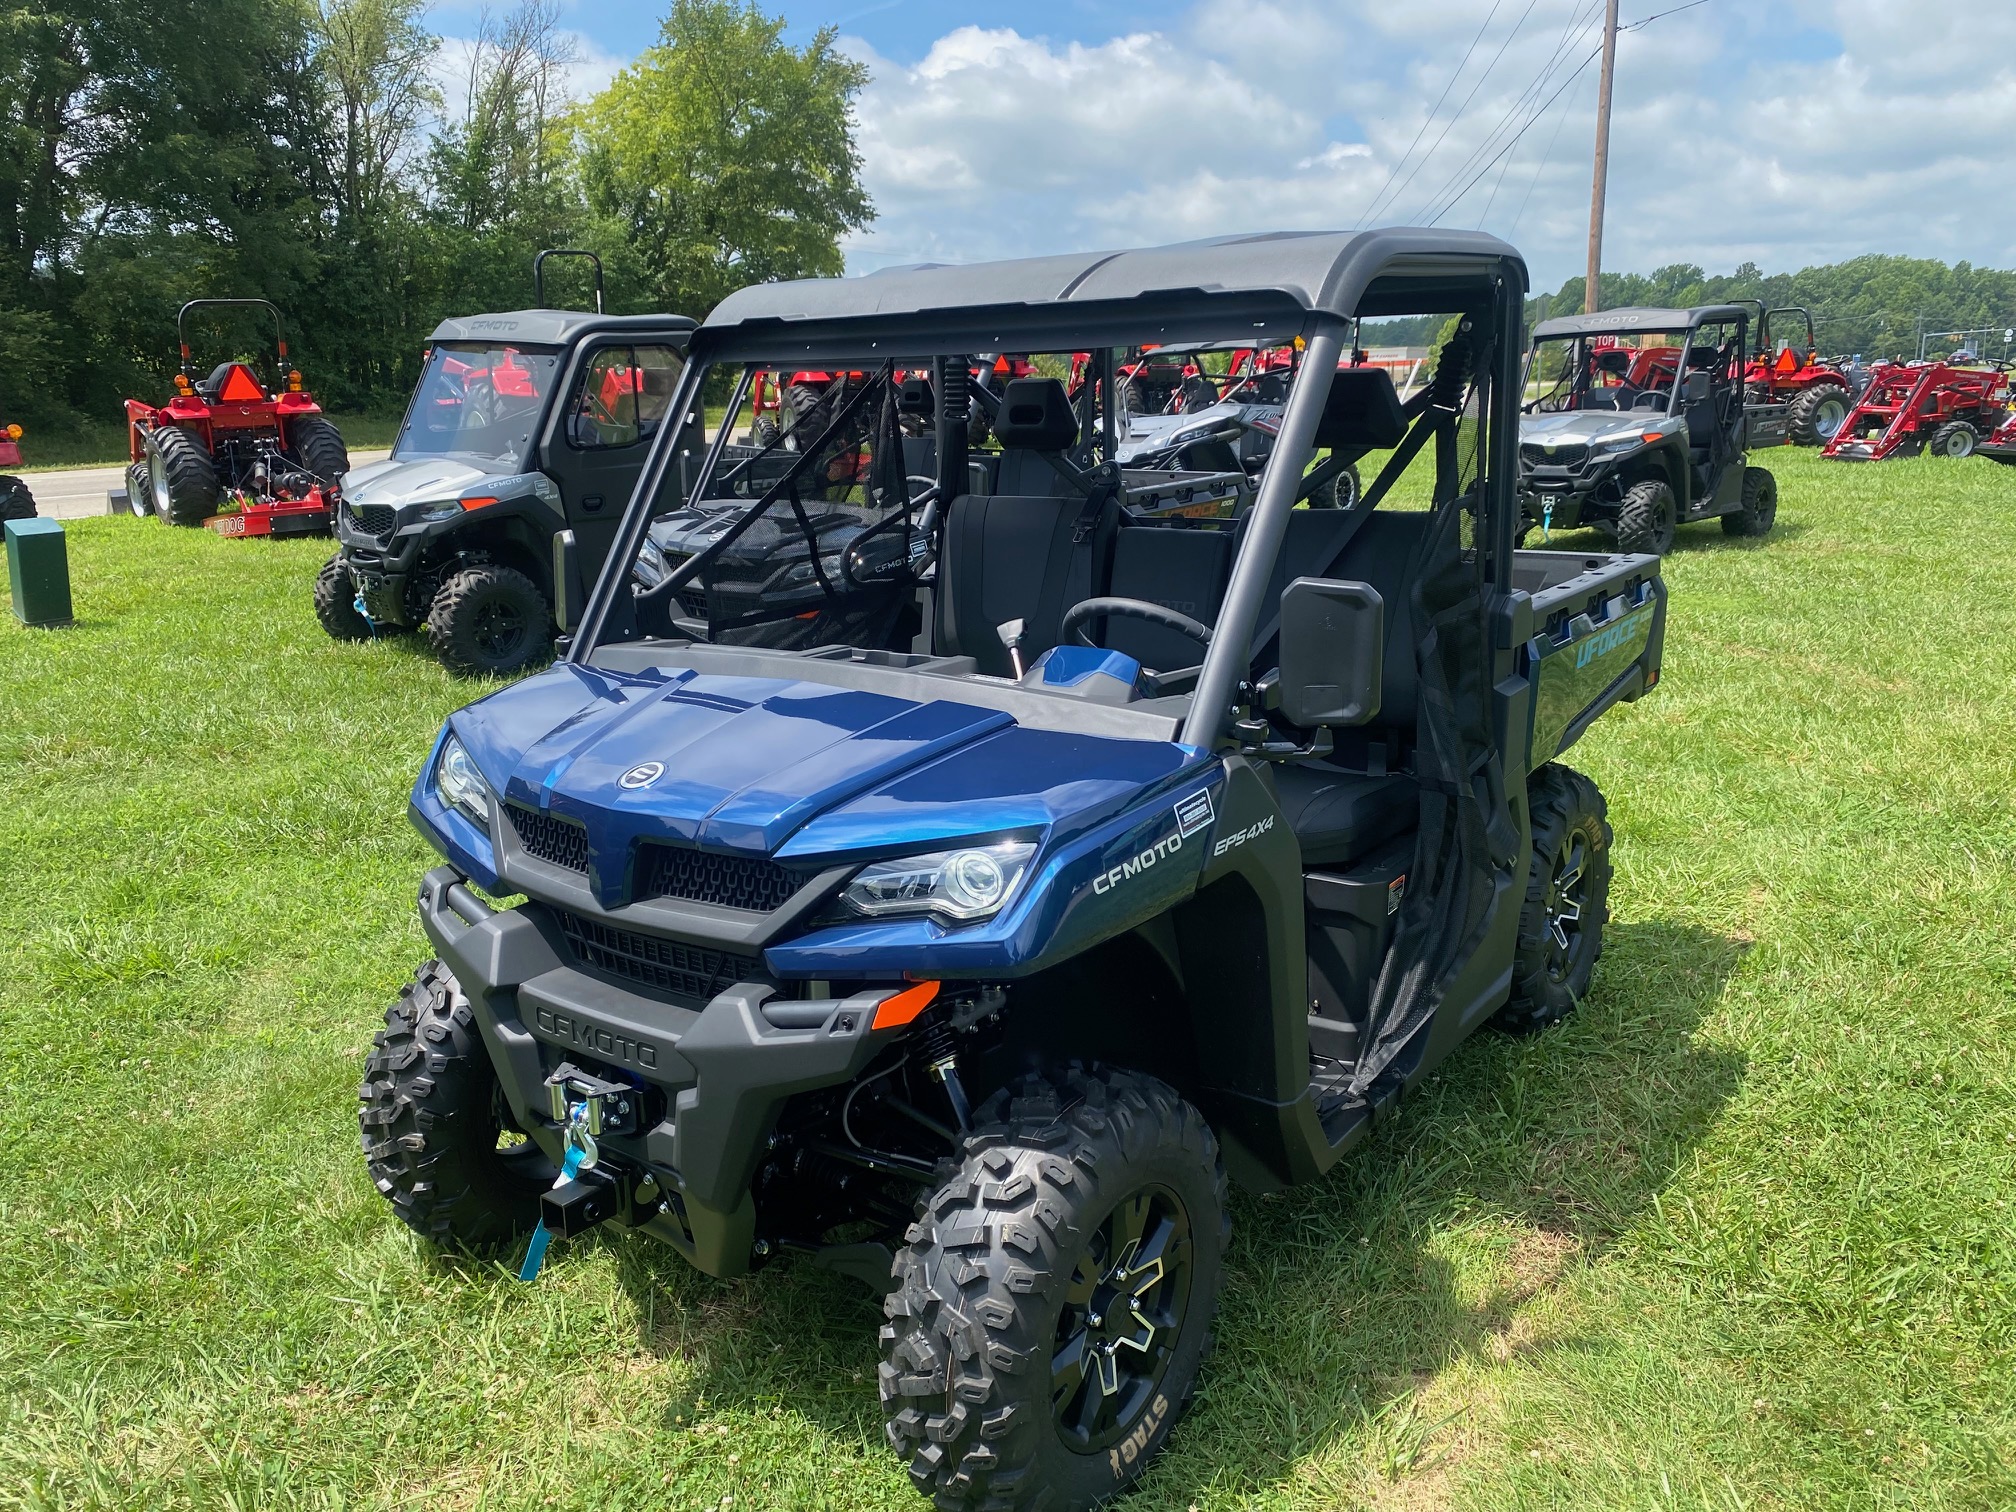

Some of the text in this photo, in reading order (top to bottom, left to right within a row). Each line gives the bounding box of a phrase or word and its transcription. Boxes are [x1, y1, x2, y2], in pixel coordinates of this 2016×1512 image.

[469, 320, 519, 332] CFMOTO
[1583, 315, 1639, 326] CFMOTO
[487, 477, 523, 490] CFMOTO
[1220, 499, 1236, 507] 1000
[1576, 615, 1640, 670] UFORCE
[1092, 833, 1183, 896] CFMOTO
[535, 1006, 659, 1071] CFMOTO
[1120, 1393, 1169, 1465] STAG
